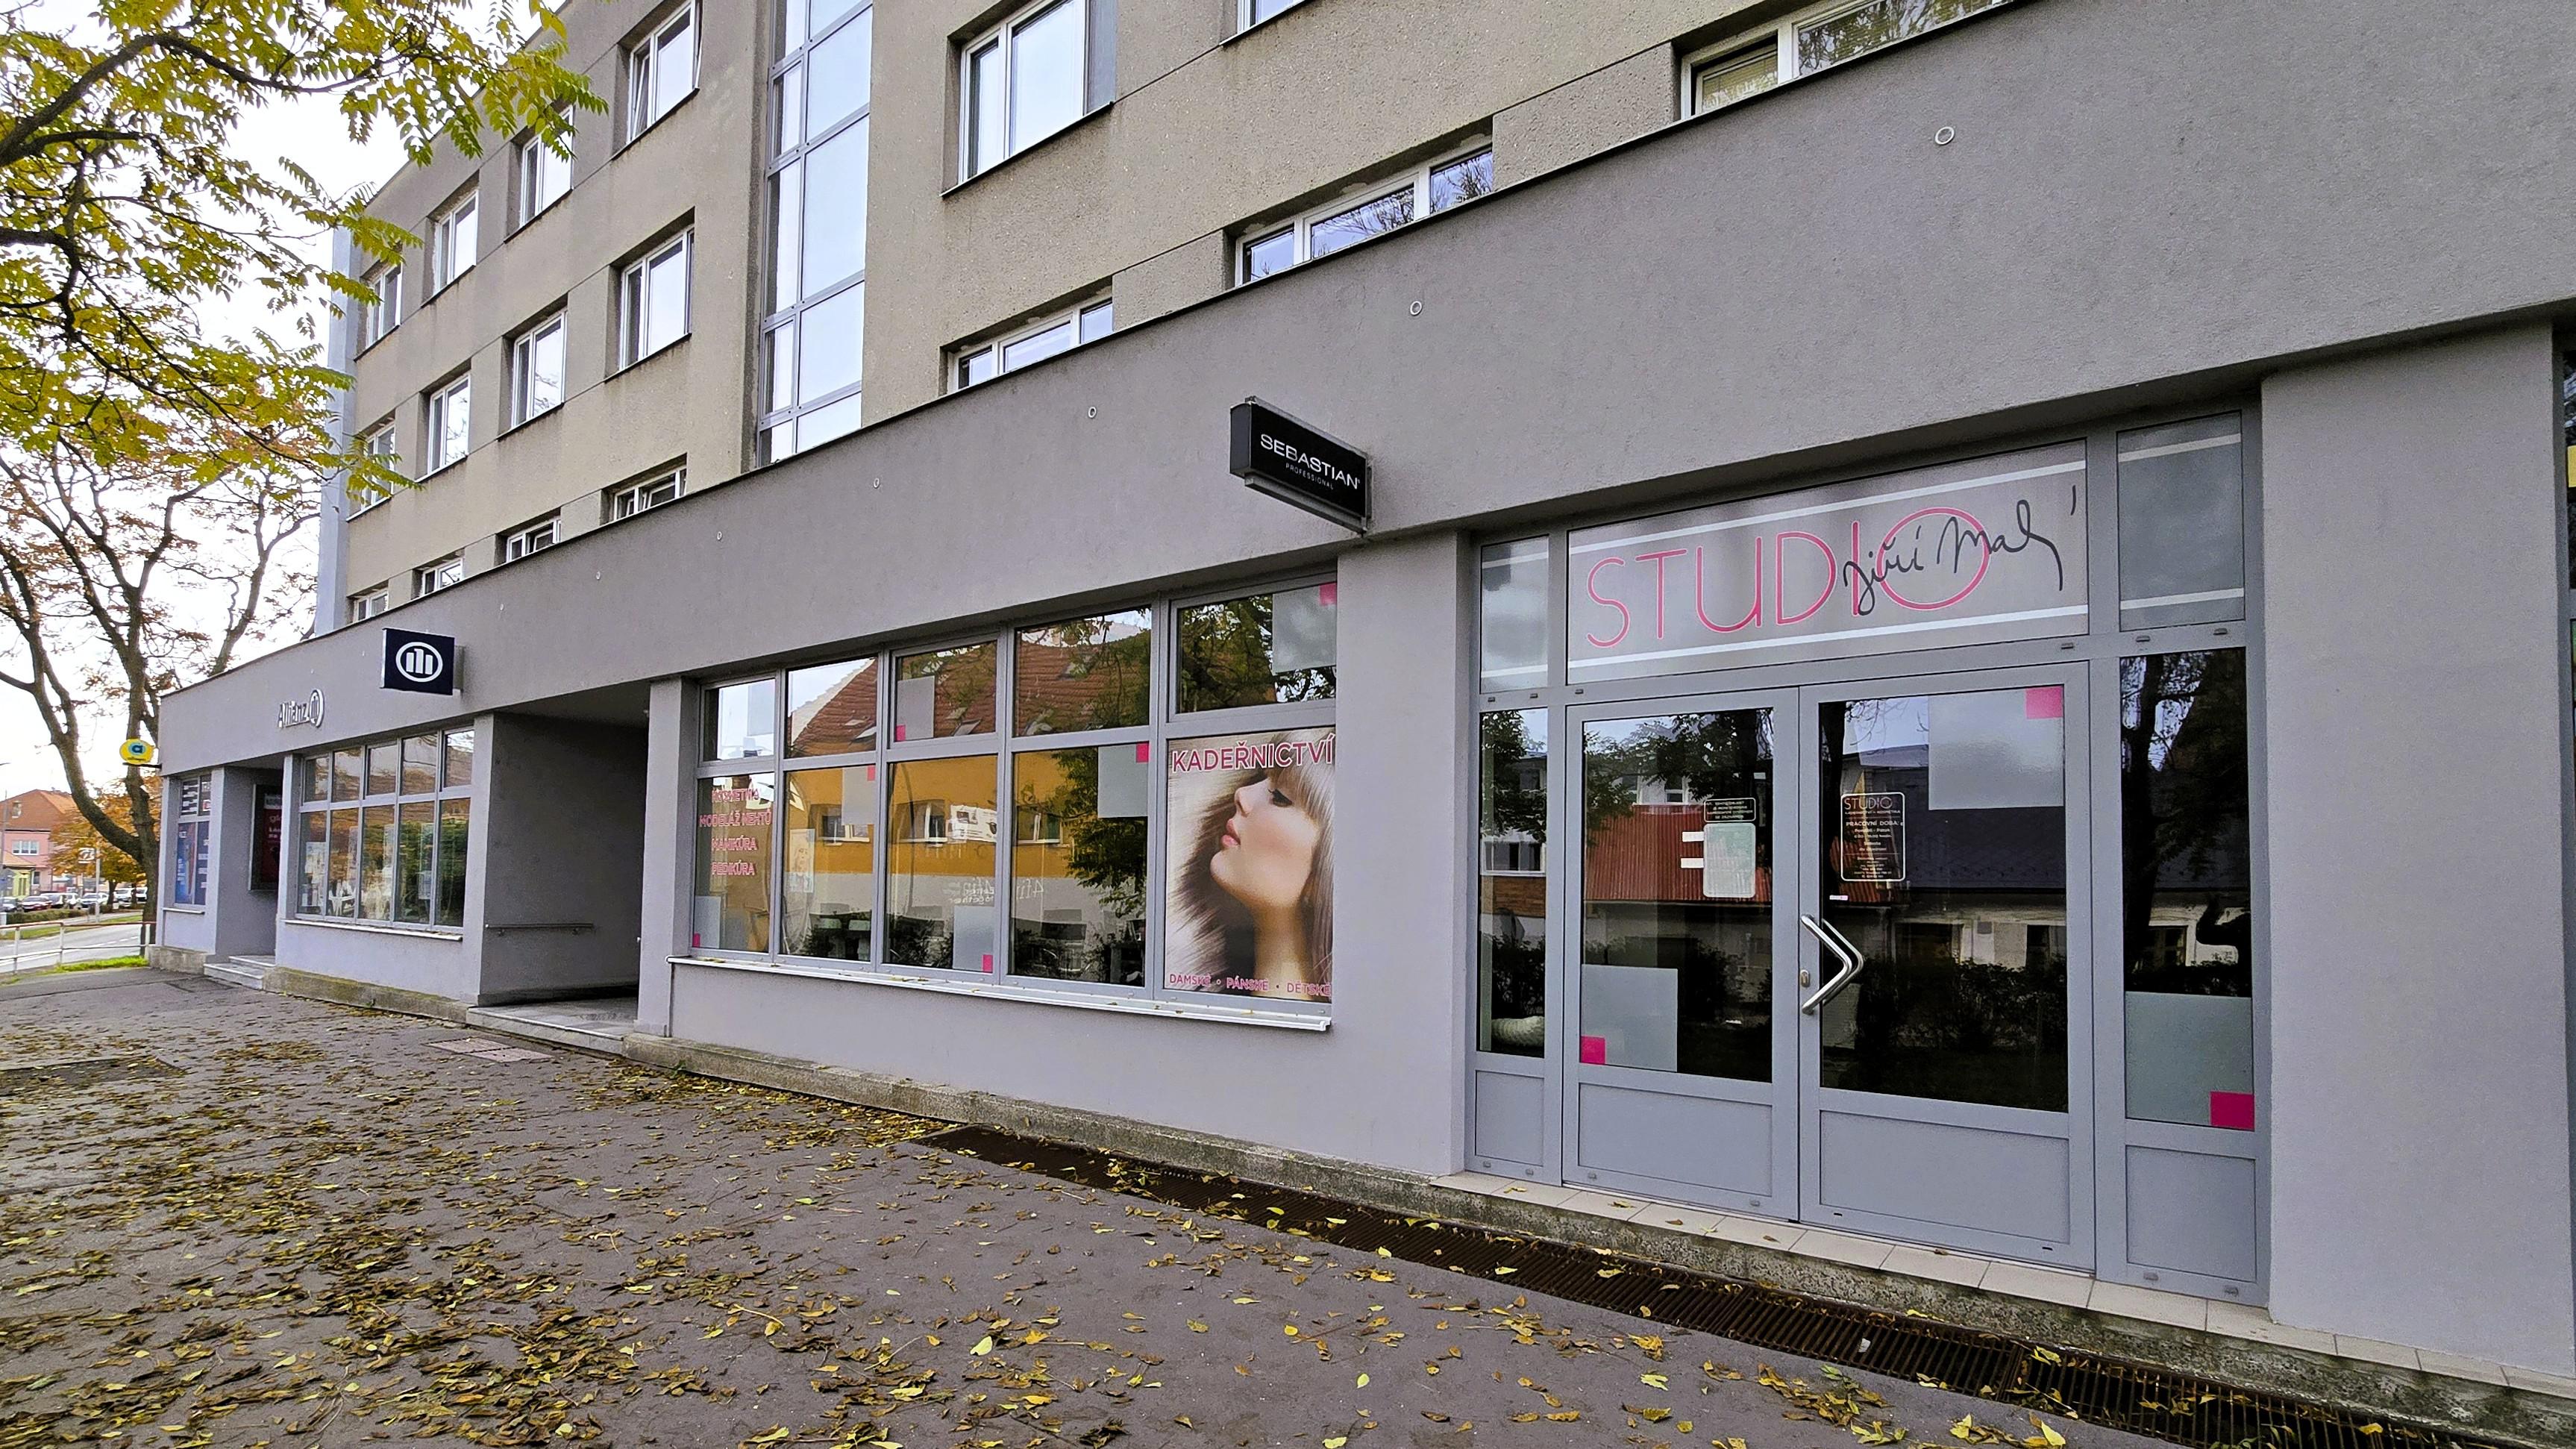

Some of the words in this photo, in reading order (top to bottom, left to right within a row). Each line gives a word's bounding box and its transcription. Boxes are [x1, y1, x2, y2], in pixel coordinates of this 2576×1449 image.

[1260, 434, 1358, 490] SEBASTIAN
[1285, 463, 1334, 490] PROFESSIONAL
[1586, 507, 1990, 648] STUDIO
[278, 700, 310, 728] Allianz
[1172, 733, 1335, 774] KADEŘNICTVÍ
[1844, 796, 1893, 810] STUDIO
[699, 810, 741, 827] MODELÁŽ
[711, 834, 758, 851] MANIKÚRA
[711, 860, 756, 877] PEDIKÚRA
